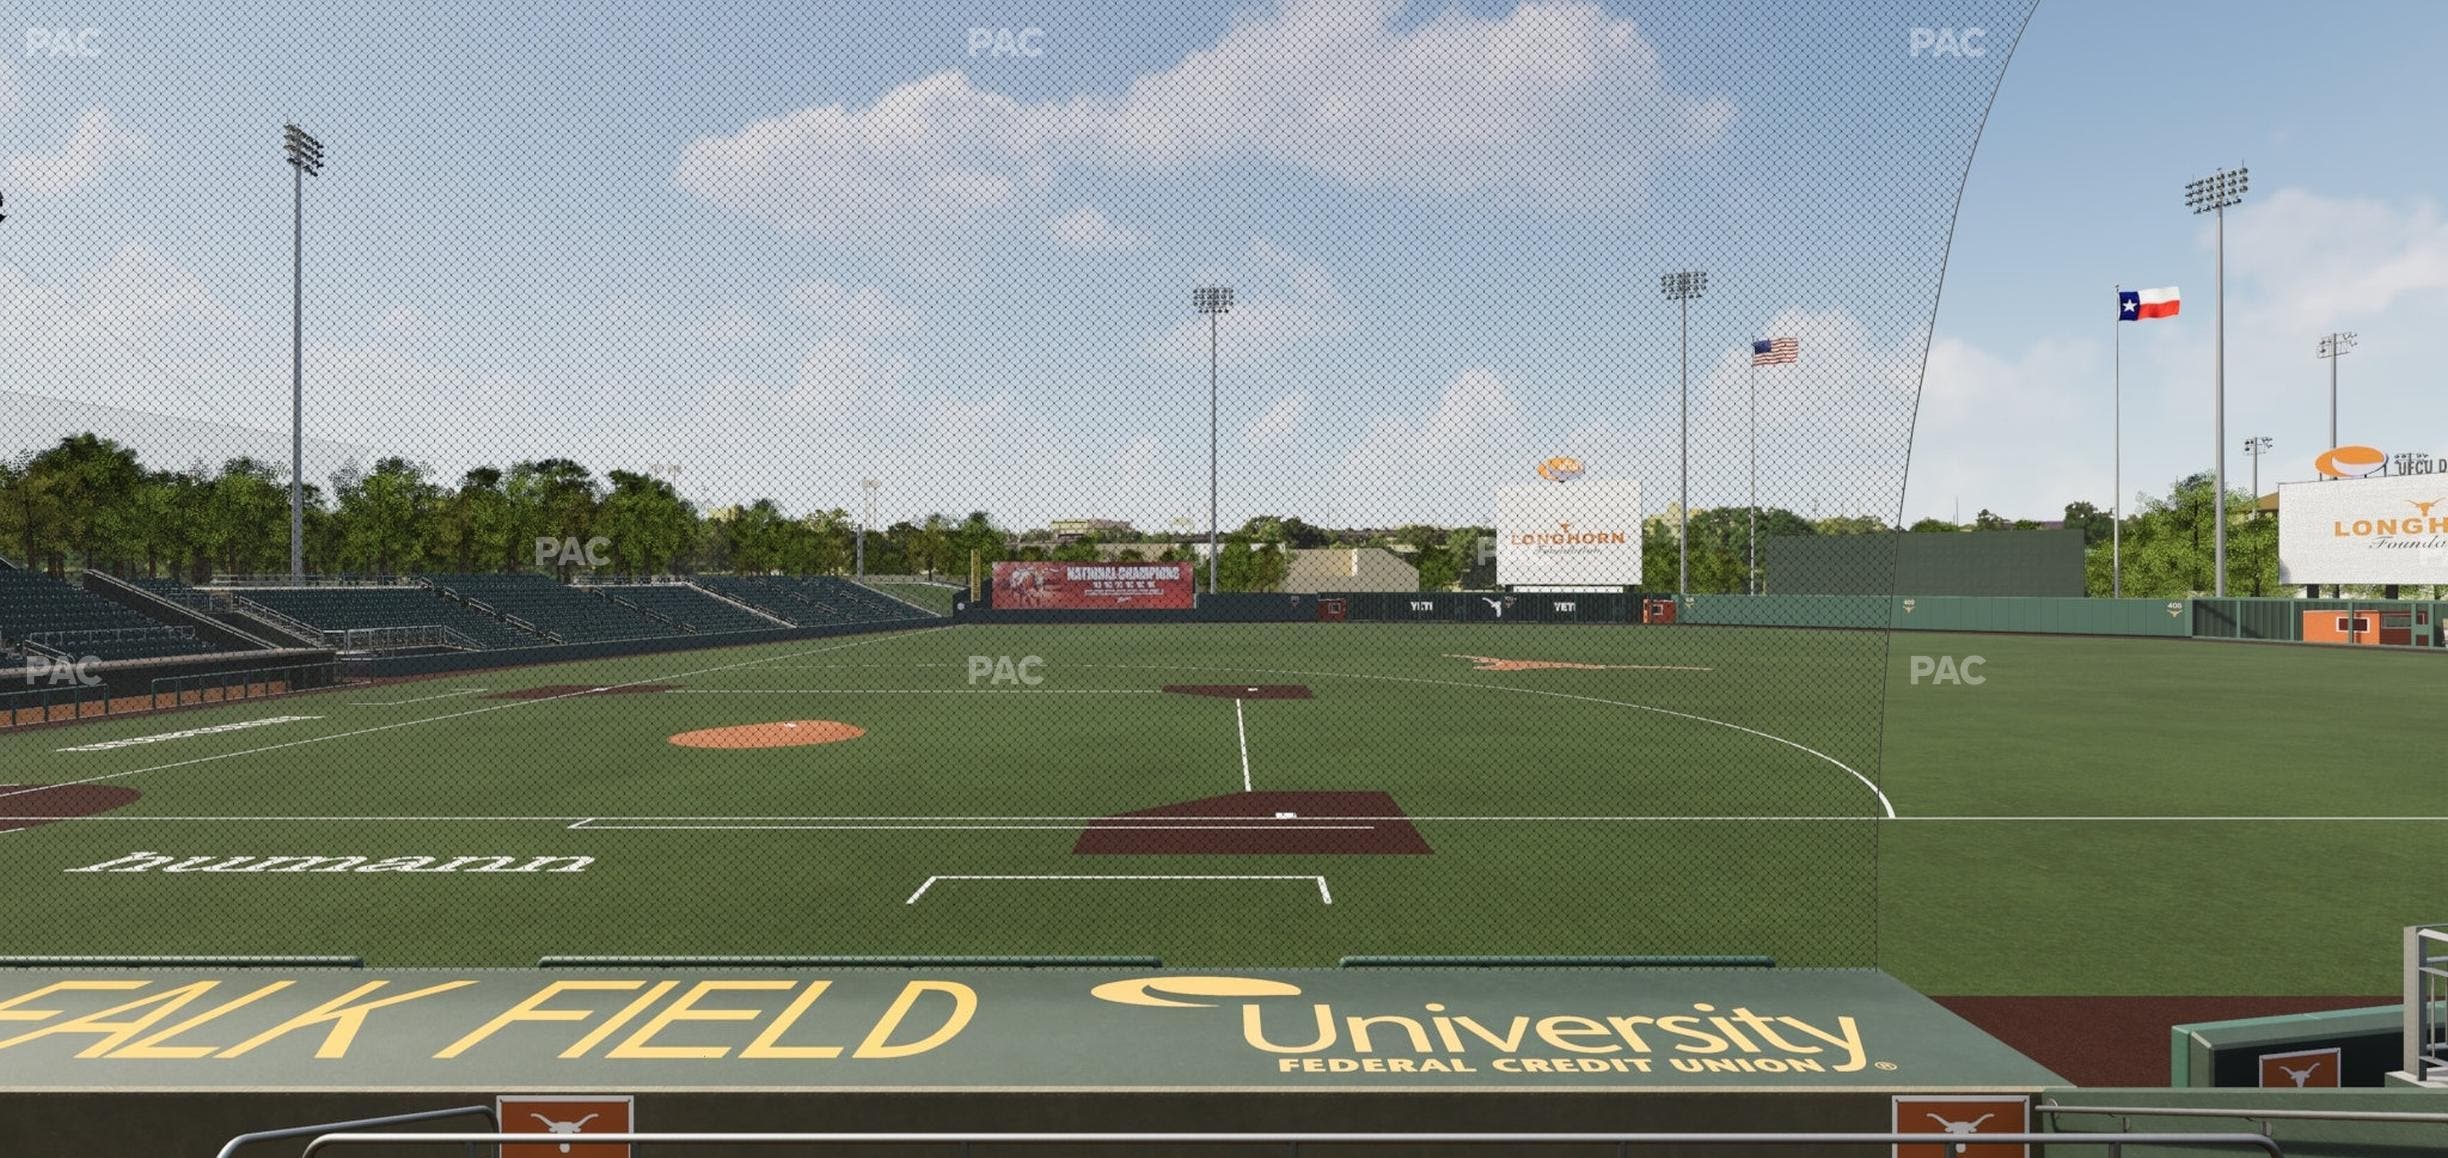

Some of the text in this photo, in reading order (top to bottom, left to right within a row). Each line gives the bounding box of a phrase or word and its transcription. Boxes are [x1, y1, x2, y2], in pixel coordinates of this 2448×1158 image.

[2399, 459, 2433, 475] UFCU
[1511, 532, 1625, 545] LONGHORN
[1067, 566, 1180, 580] NATIONAL CHAMPIONS
[1553, 601, 1576, 612] YETI
[63, 851, 596, 872] humann
[431, 980, 977, 1059] FIELD
[1242, 1002, 1867, 1072] University
[1278, 1058, 1827, 1073] FEDERAL CREDIT UNION
